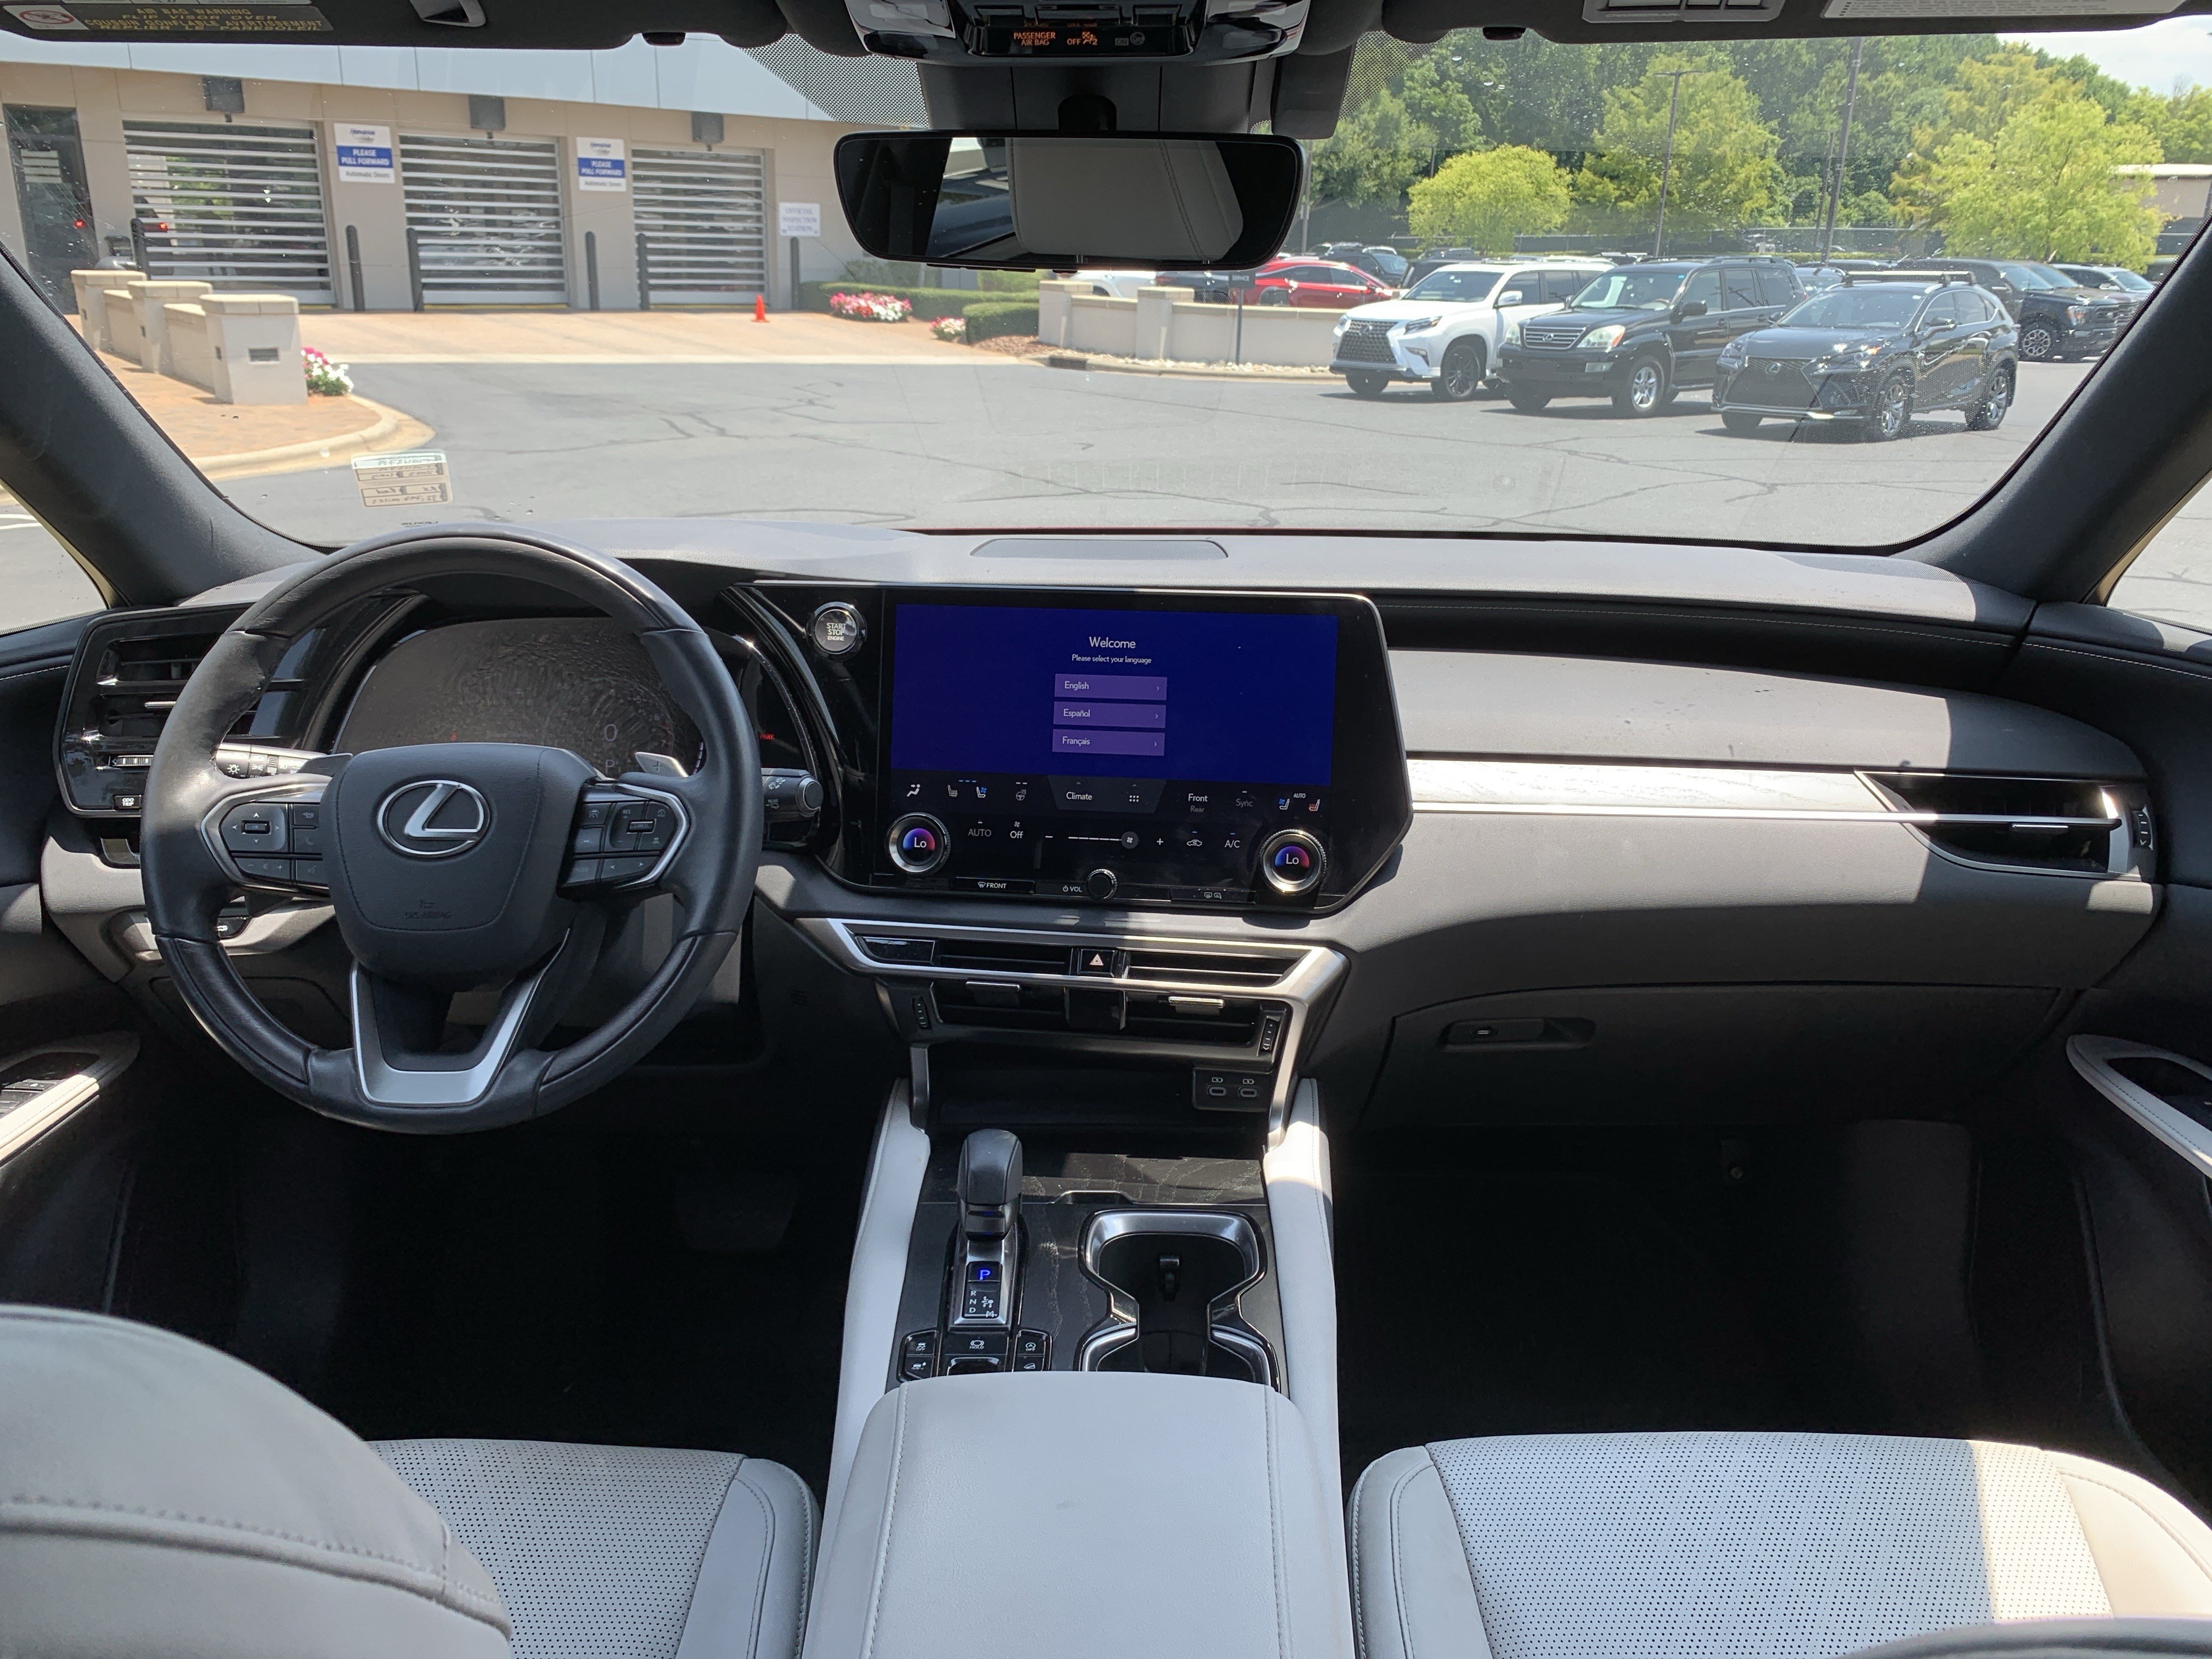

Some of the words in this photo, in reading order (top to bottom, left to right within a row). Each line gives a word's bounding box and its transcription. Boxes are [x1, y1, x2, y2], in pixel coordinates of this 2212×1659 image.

[1013, 31, 1056, 40] PASSENGER
[352, 149, 376, 157] PLEASE
[341, 156, 357, 165] PULL
[357, 157, 390, 166] FORWARD
[1089, 636, 1136, 648] Welcome
[1125, 656, 1152, 664] language
[1064, 681, 1089, 691] English
[1063, 709, 1090, 718] Español
[1062, 736, 1090, 747] Français
[605, 760, 615, 774] P
[1066, 792, 1093, 800] Climate
[1188, 793, 1208, 802] Front
[1235, 798, 1253, 808] Sync
[968, 829, 992, 837] AUTO
[1010, 831, 1024, 839] Off
[914, 837, 927, 848] Lo
[1224, 840, 1240, 849] A/C
[1285, 854, 1300, 865] Lo
[979, 1269, 991, 1280] P
